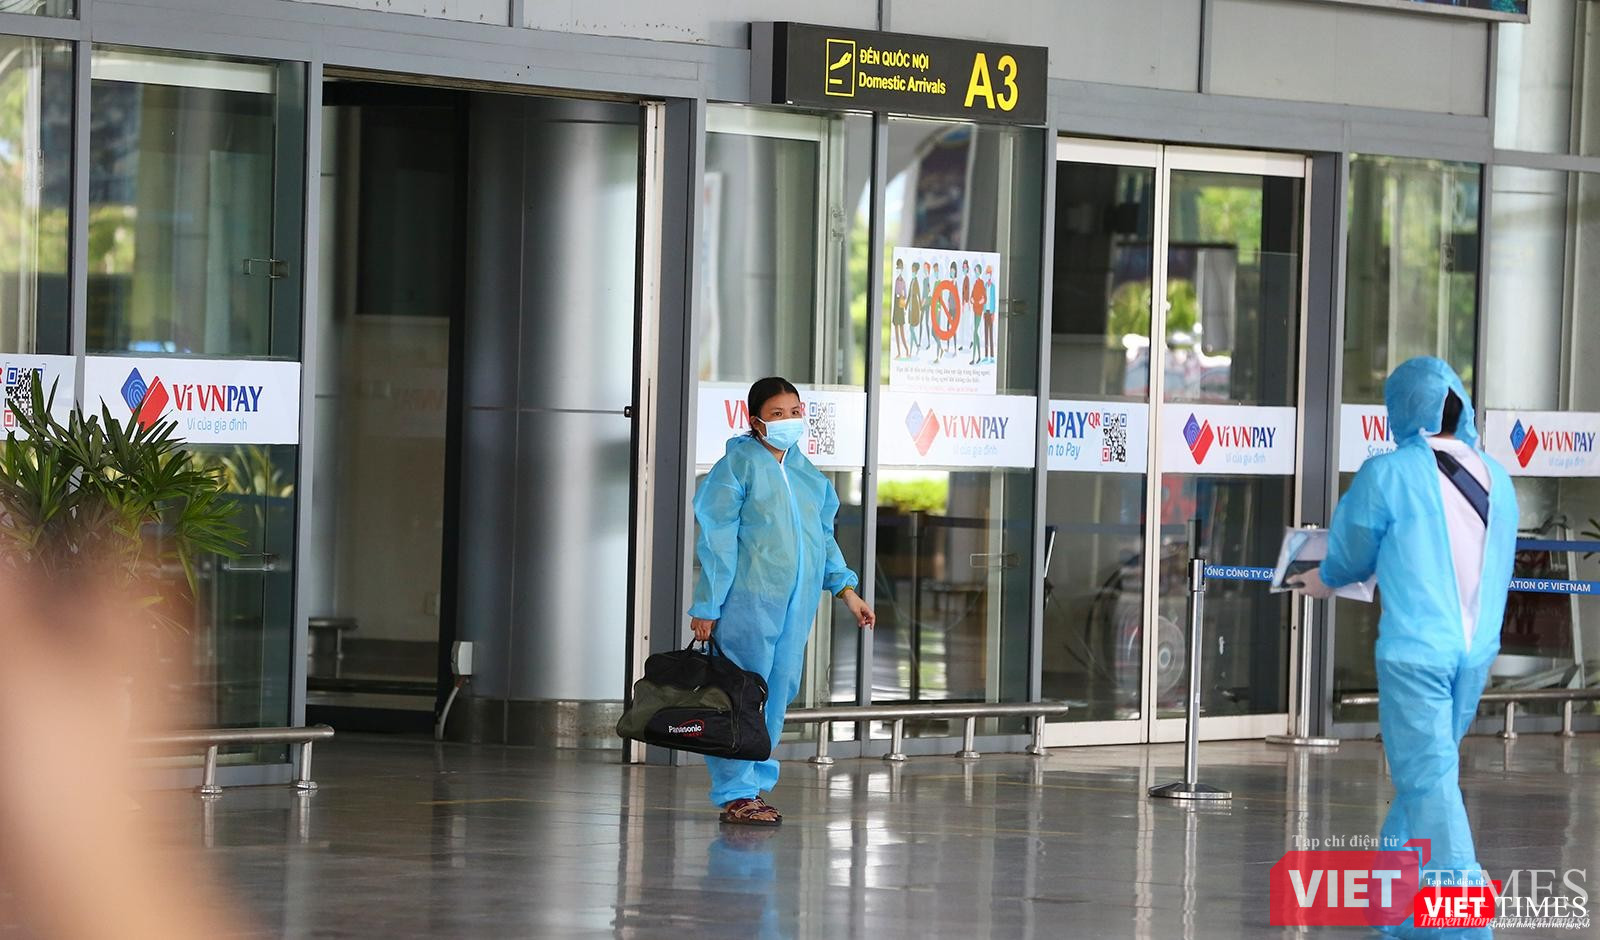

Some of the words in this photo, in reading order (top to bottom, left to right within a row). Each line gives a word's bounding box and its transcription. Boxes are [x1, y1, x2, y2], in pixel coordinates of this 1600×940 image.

[858, 72, 907, 91] Domestic
[907, 76, 947, 95] Arrivals
[963, 52, 1019, 111] A3
[172, 384, 193, 411] Ví
[196, 385, 264, 412] VNPAY
[942, 415, 958, 438] Ví
[960, 416, 1009, 440] VNPAY
[1217, 425, 1230, 447] Ví
[1232, 426, 1276, 448] VNPAY
[1066, 442, 1081, 460] Pay
[1541, 431, 1553, 451] Ví
[1556, 431, 1596, 452] VNPAY
[1226, 567, 1250, 578] CÔNG
[1250, 569, 1261, 578] TY
[1509, 580, 1536, 590] ATION
[1537, 581, 1550, 590] OF
[1551, 582, 1591, 592] VIETNAM
[668, 724, 702, 733] Panasonic
